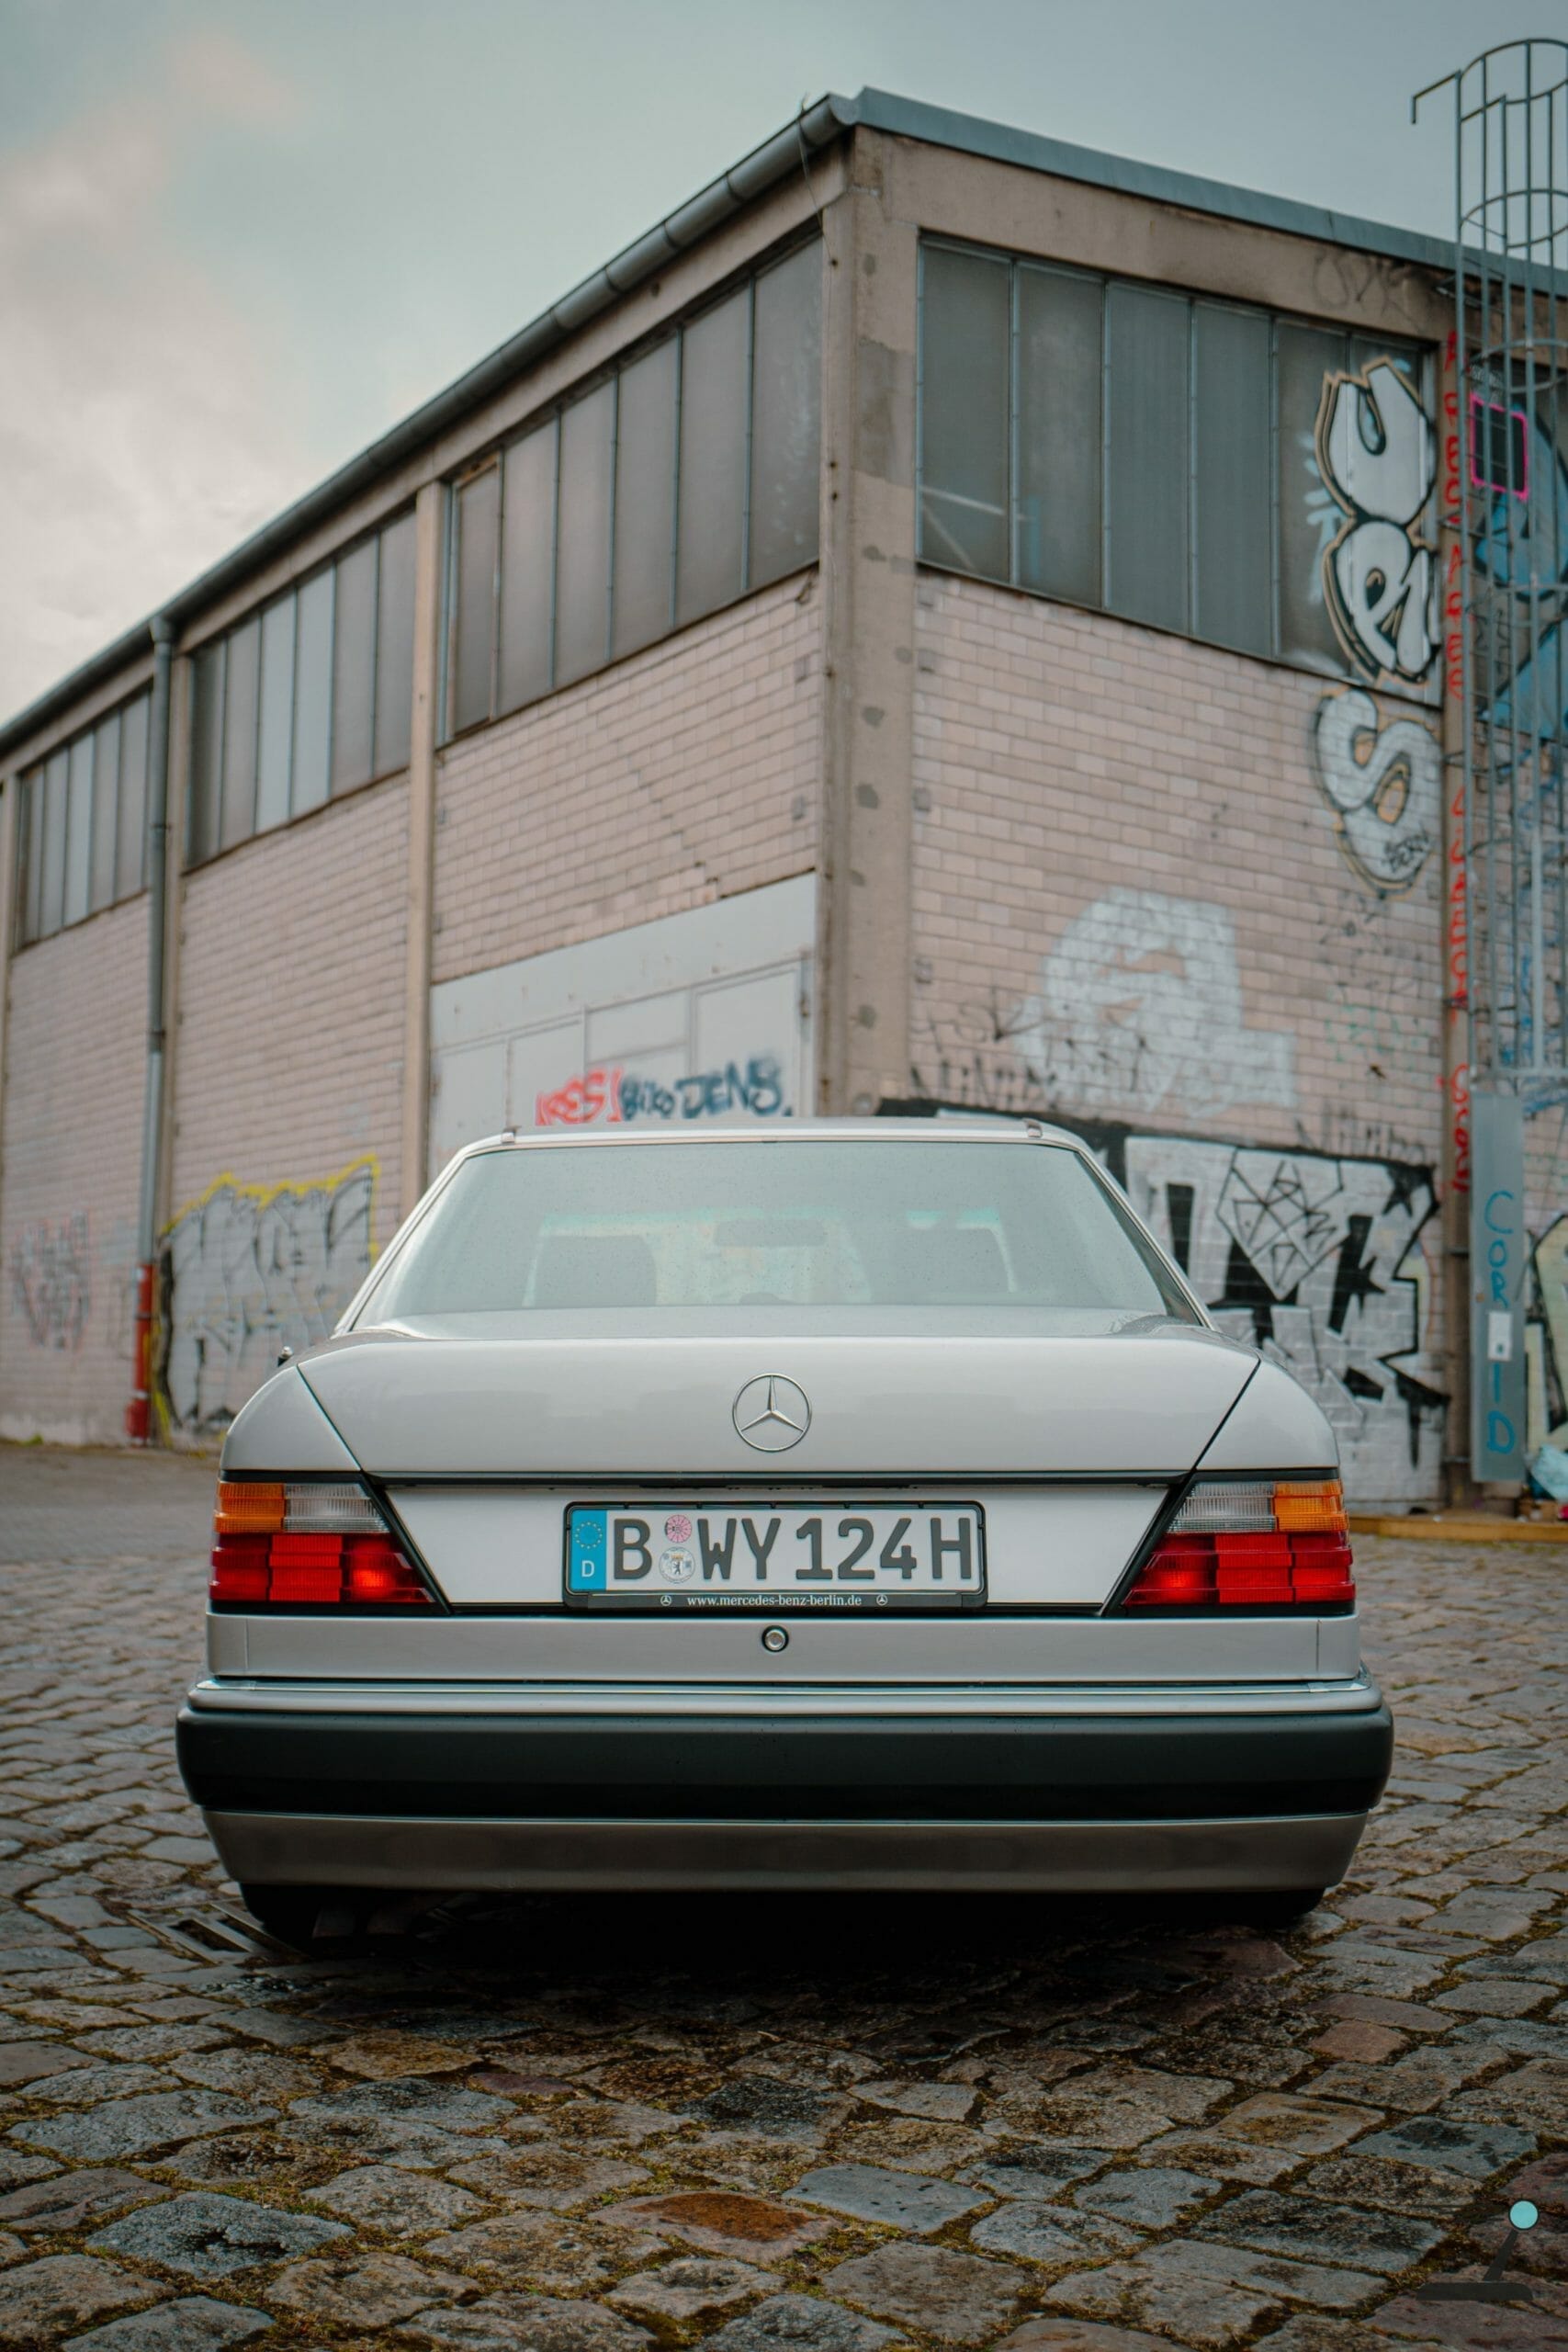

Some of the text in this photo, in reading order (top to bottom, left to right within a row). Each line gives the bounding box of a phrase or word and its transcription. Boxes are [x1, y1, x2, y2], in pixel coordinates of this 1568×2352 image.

[614, 1518, 653, 1580] B
[581, 1560, 596, 1578] D
[687, 1594, 863, 1607] www.mercedes-benz-berlin.de
